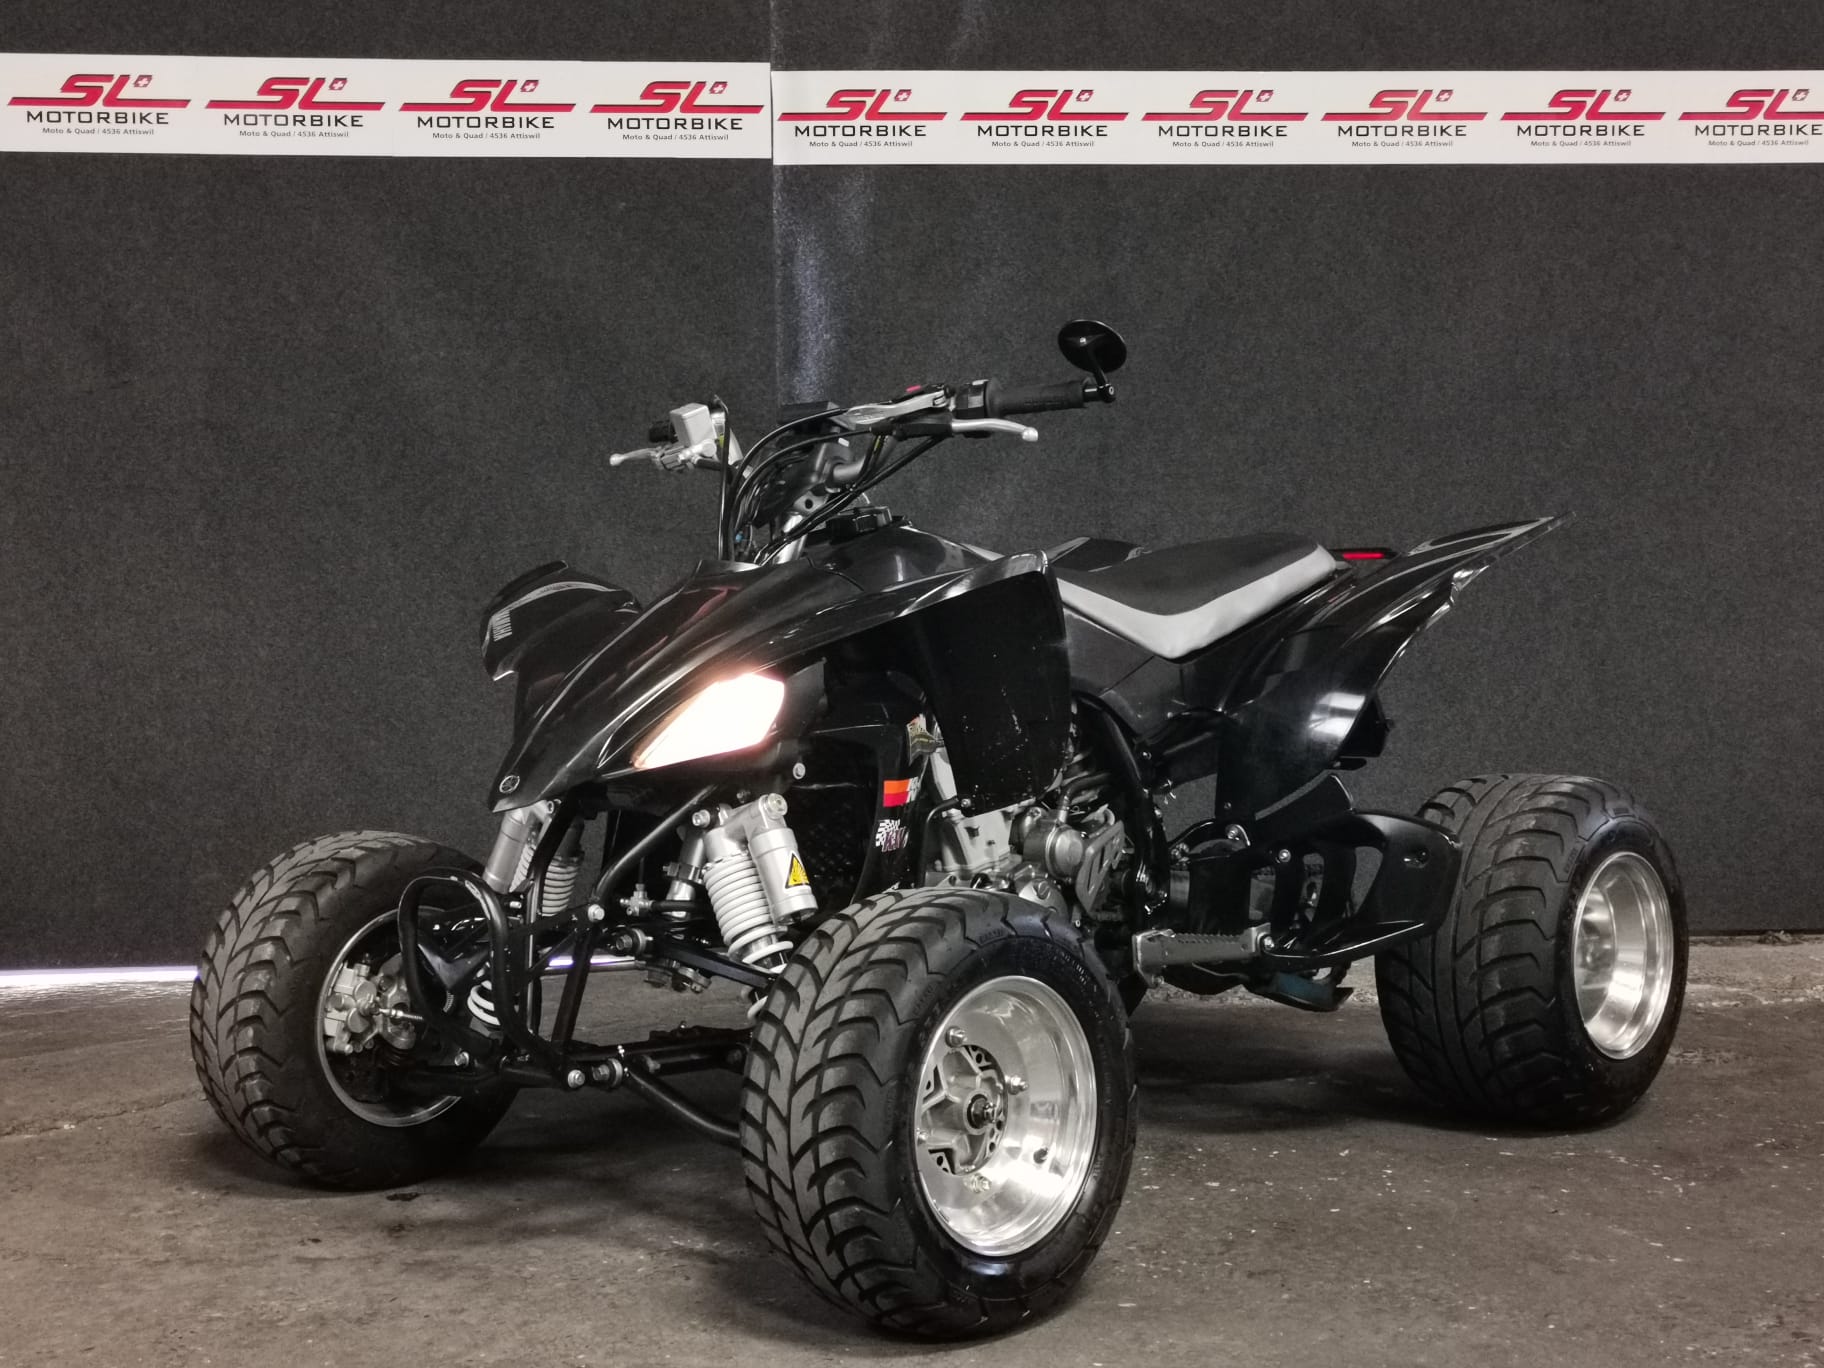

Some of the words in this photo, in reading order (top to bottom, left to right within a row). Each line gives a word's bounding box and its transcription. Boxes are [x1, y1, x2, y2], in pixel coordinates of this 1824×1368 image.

[27, 111, 168, 124] MOTORBIKE
[224, 114, 363, 127] MOTORBIKE
[418, 116, 554, 128] MOTORBIKE
[608, 118, 742, 130] MOTORBIKE
[1695, 124, 1823, 136] MOTORBIKE
[74, 128, 95, 136] Quad
[271, 130, 291, 138] Quad
[464, 132, 483, 140] Quad
[795, 125, 926, 137] MOTORBIKE
[978, 125, 1108, 137] MOTORBIKE
[1159, 125, 1288, 137] MOTORBIKE
[1338, 125, 1466, 136] MOTORBIKE
[1517, 125, 1645, 136] MOTORBIKE
[653, 134, 672, 142] Quad
